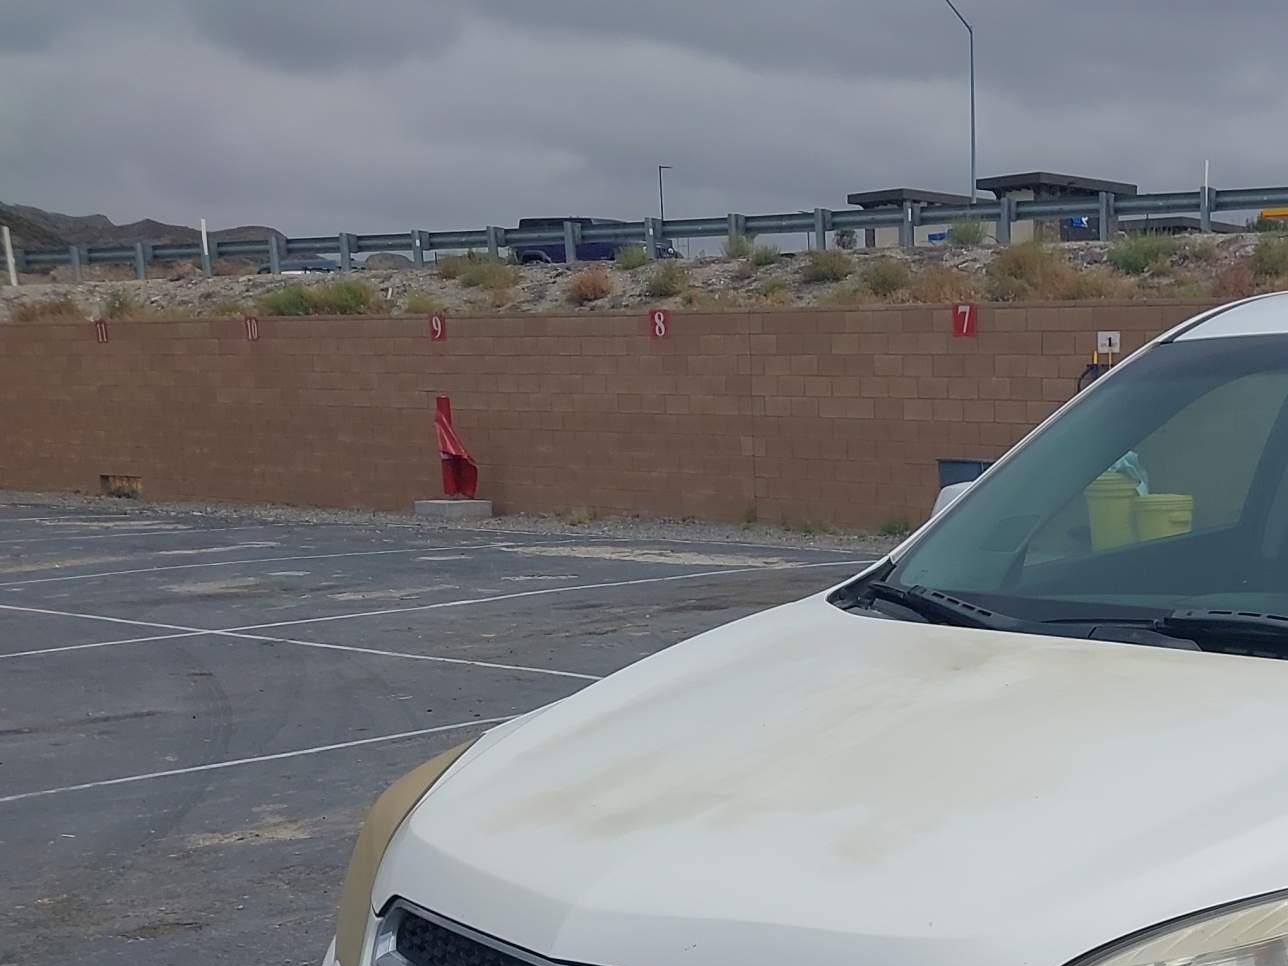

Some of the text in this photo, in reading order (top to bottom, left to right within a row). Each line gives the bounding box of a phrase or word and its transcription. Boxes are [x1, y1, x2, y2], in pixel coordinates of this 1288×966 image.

[246, 318, 259, 340] 10
[432, 315, 442, 338] 9
[654, 311, 666, 337] 8
[957, 304, 970, 333] 7
[96, 322, 108, 342] 11
